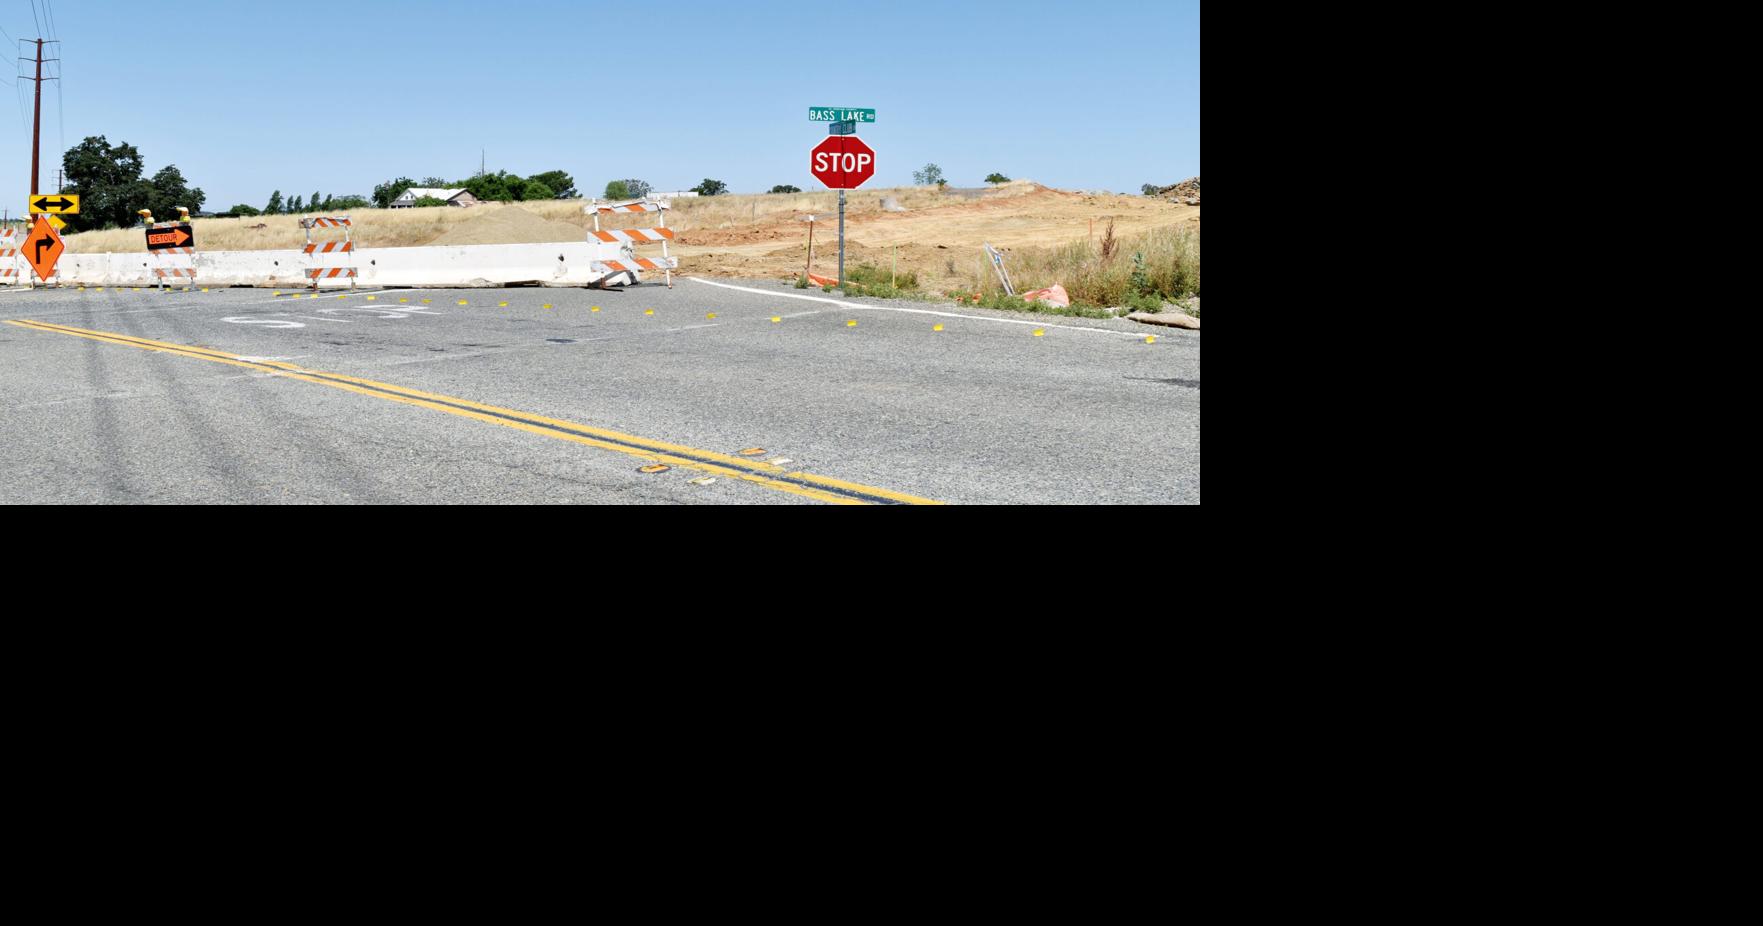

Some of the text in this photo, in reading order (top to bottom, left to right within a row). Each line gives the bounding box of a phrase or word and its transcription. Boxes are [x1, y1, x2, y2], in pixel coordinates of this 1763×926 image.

[810, 110, 835, 120] BASS
[841, 111, 865, 121] LAKE
[815, 152, 871, 173] STOP
[150, 233, 178, 243] DETOUR
